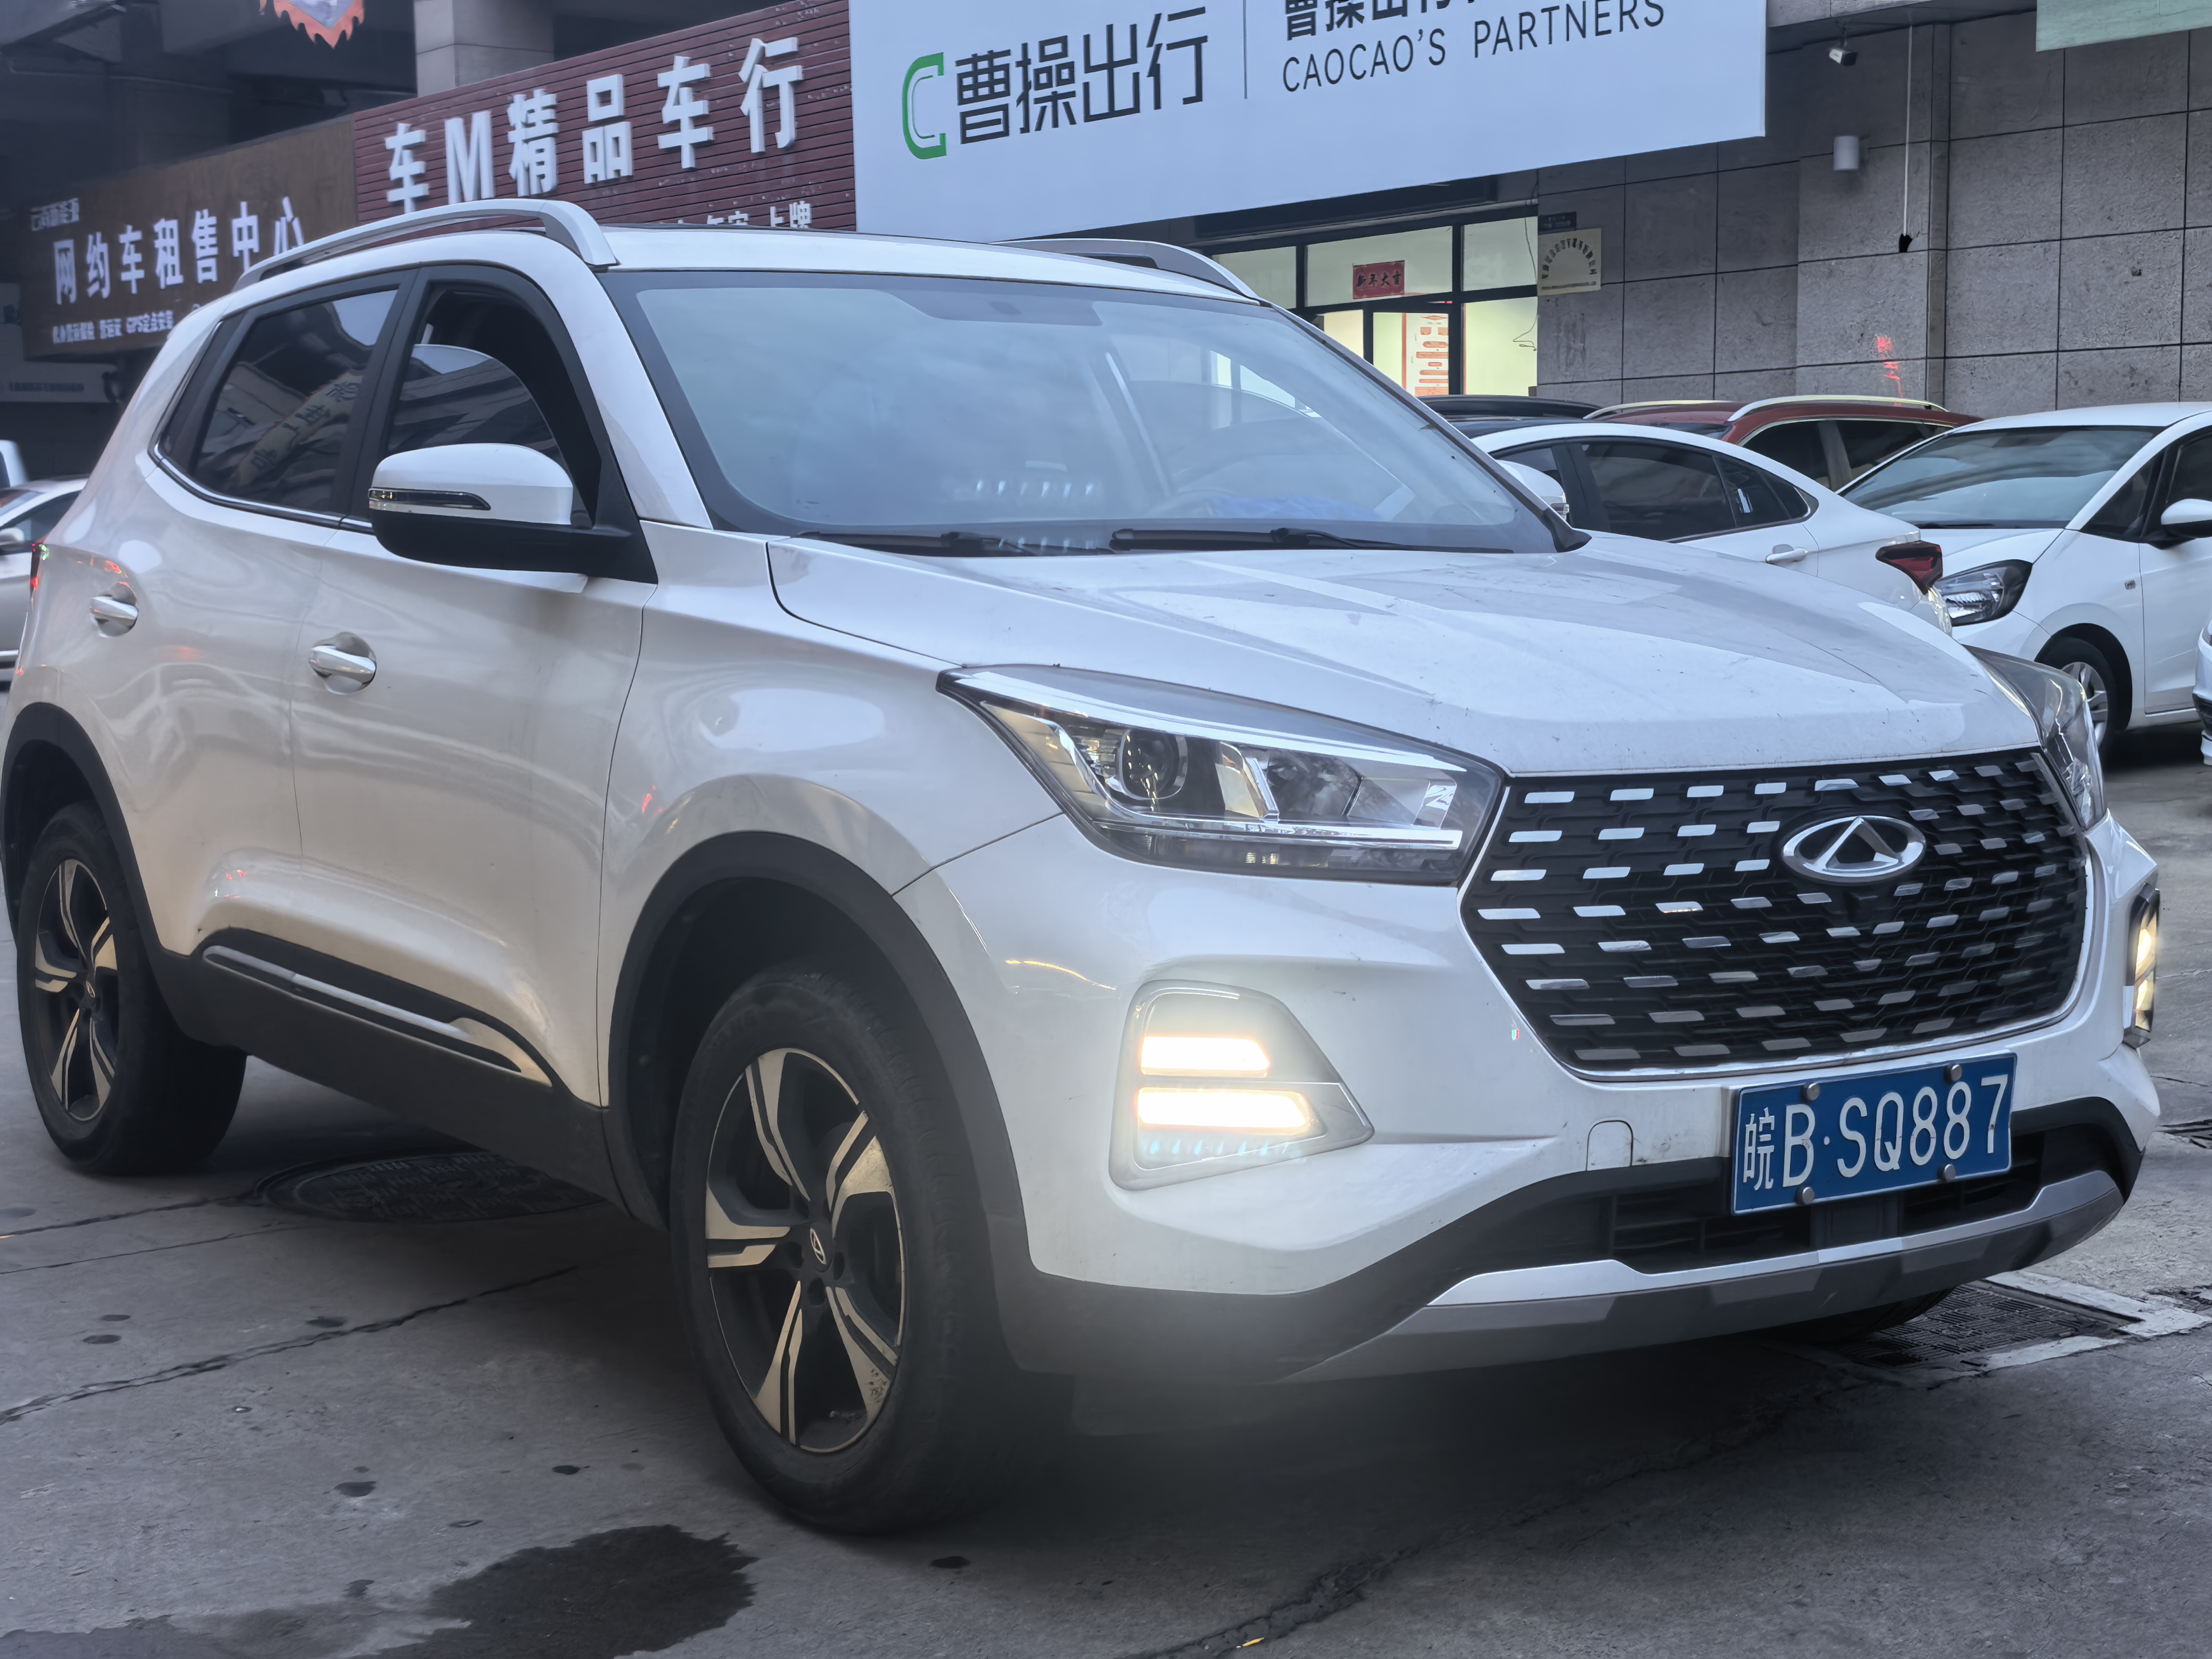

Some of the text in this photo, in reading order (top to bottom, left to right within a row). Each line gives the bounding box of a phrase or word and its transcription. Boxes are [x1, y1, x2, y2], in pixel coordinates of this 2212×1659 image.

[955, 6, 1209, 145] 曹操出行
[1283, 0, 1664, 92] CAOCAO'S PARTNERS
[385, 37, 804, 213] 车M精品车行
[53, 197, 304, 305] 网约车租售中心
[1743, 1074, 2008, 1191] 皖B·SQ887
